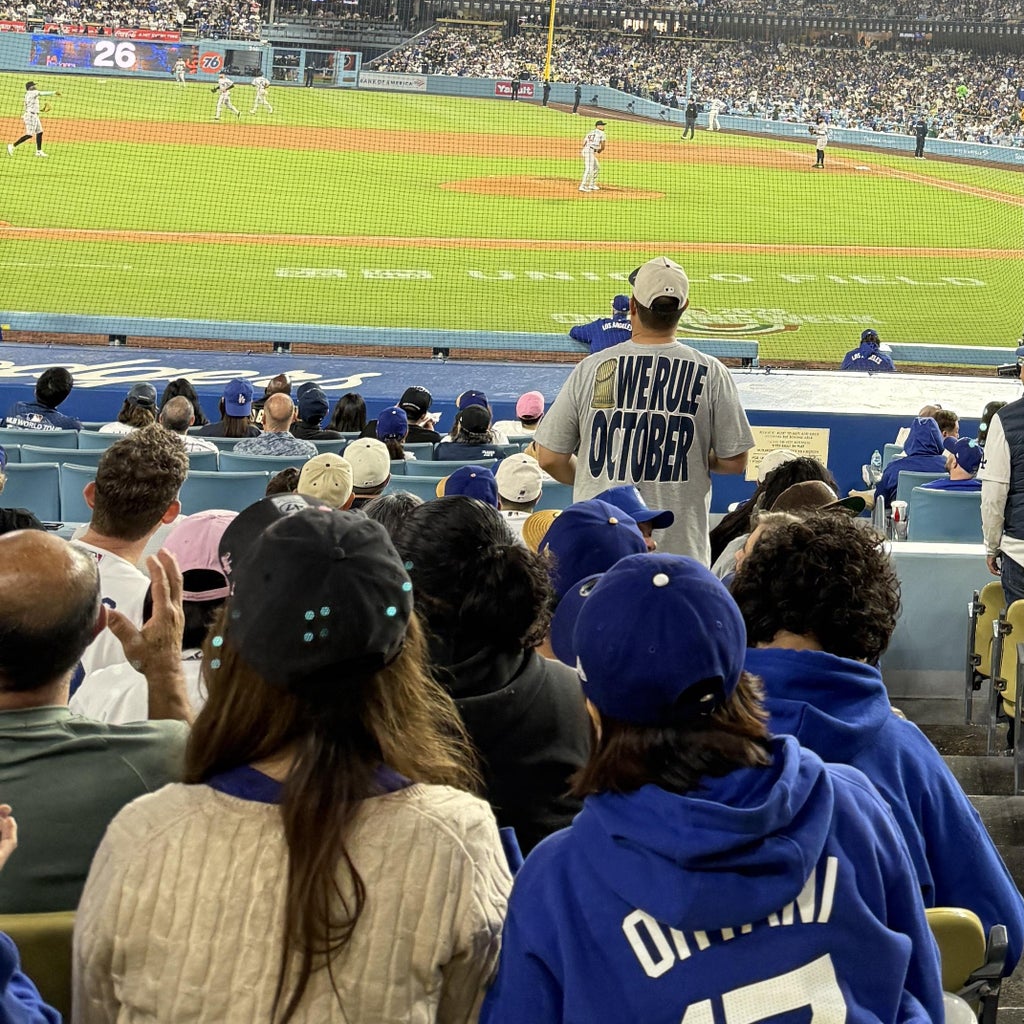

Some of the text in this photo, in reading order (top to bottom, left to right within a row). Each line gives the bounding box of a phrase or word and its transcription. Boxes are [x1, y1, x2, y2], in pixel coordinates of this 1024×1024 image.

[93, 41, 136, 68] 26
[203, 57, 221, 69] 76
[498, 84, 533, 95] Yault
[467, 270, 986, 286] UNIO FIELD
[602, 322, 611, 330] LOS
[617, 355, 708, 416] WE RULE
[19, 420, 42, 429] WORLD
[589, 410, 695, 483] OCTOBER
[622, 856, 839, 978] ONI
